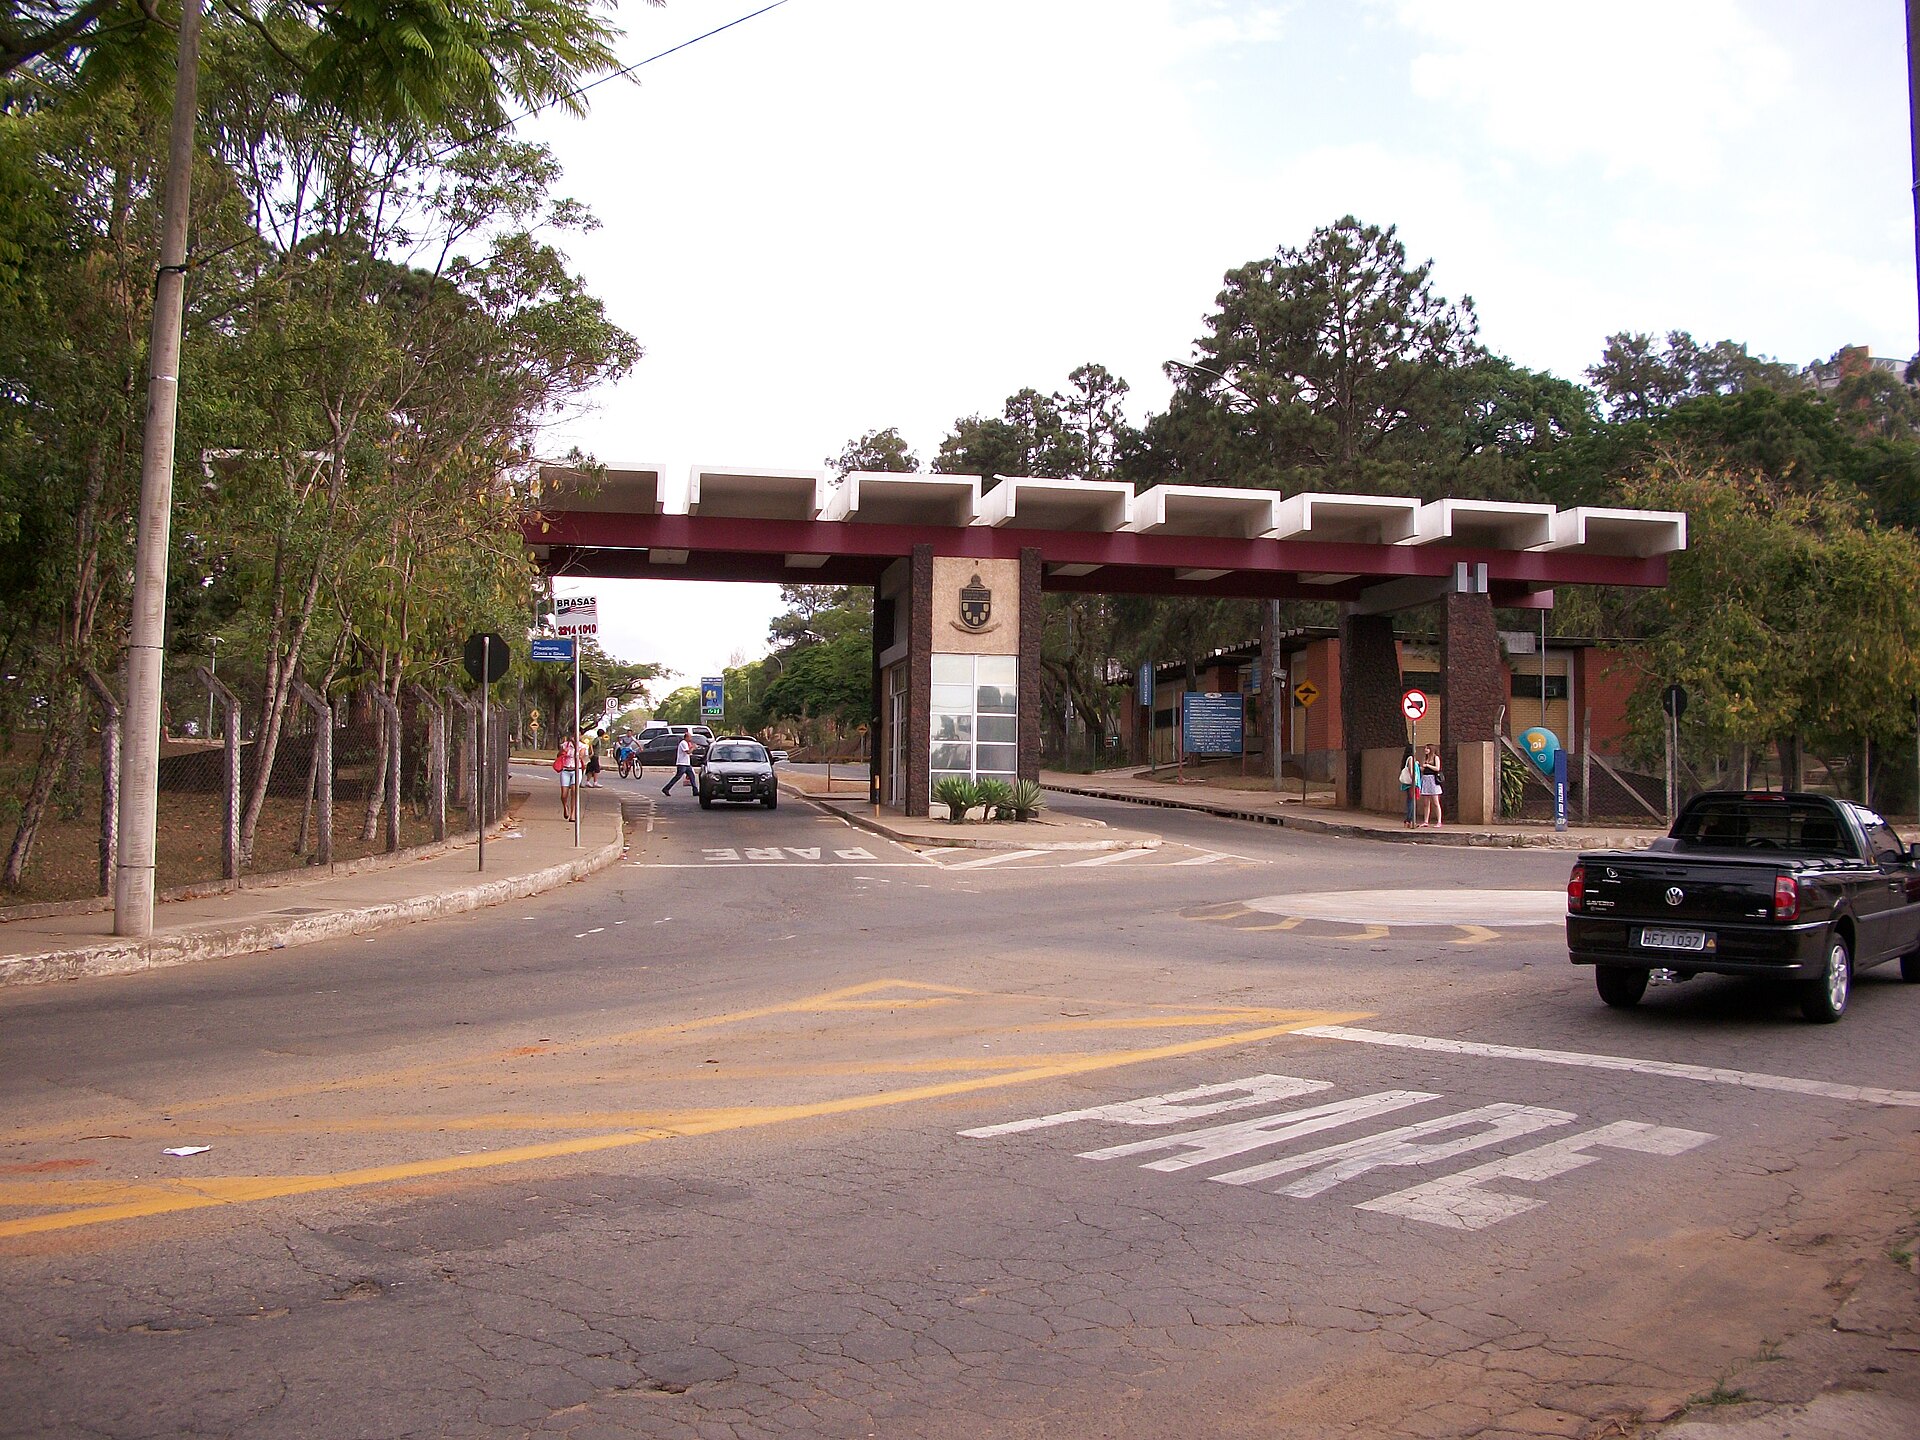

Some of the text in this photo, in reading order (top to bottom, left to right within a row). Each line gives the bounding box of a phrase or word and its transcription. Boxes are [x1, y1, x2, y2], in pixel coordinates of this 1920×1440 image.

[557, 597, 596, 607] BRASAS
[578, 624, 597, 634] 1010
[1532, 738, 1542, 749] oi
[701, 846, 878, 861] PARE
[955, 1073, 1721, 1231] PARE
